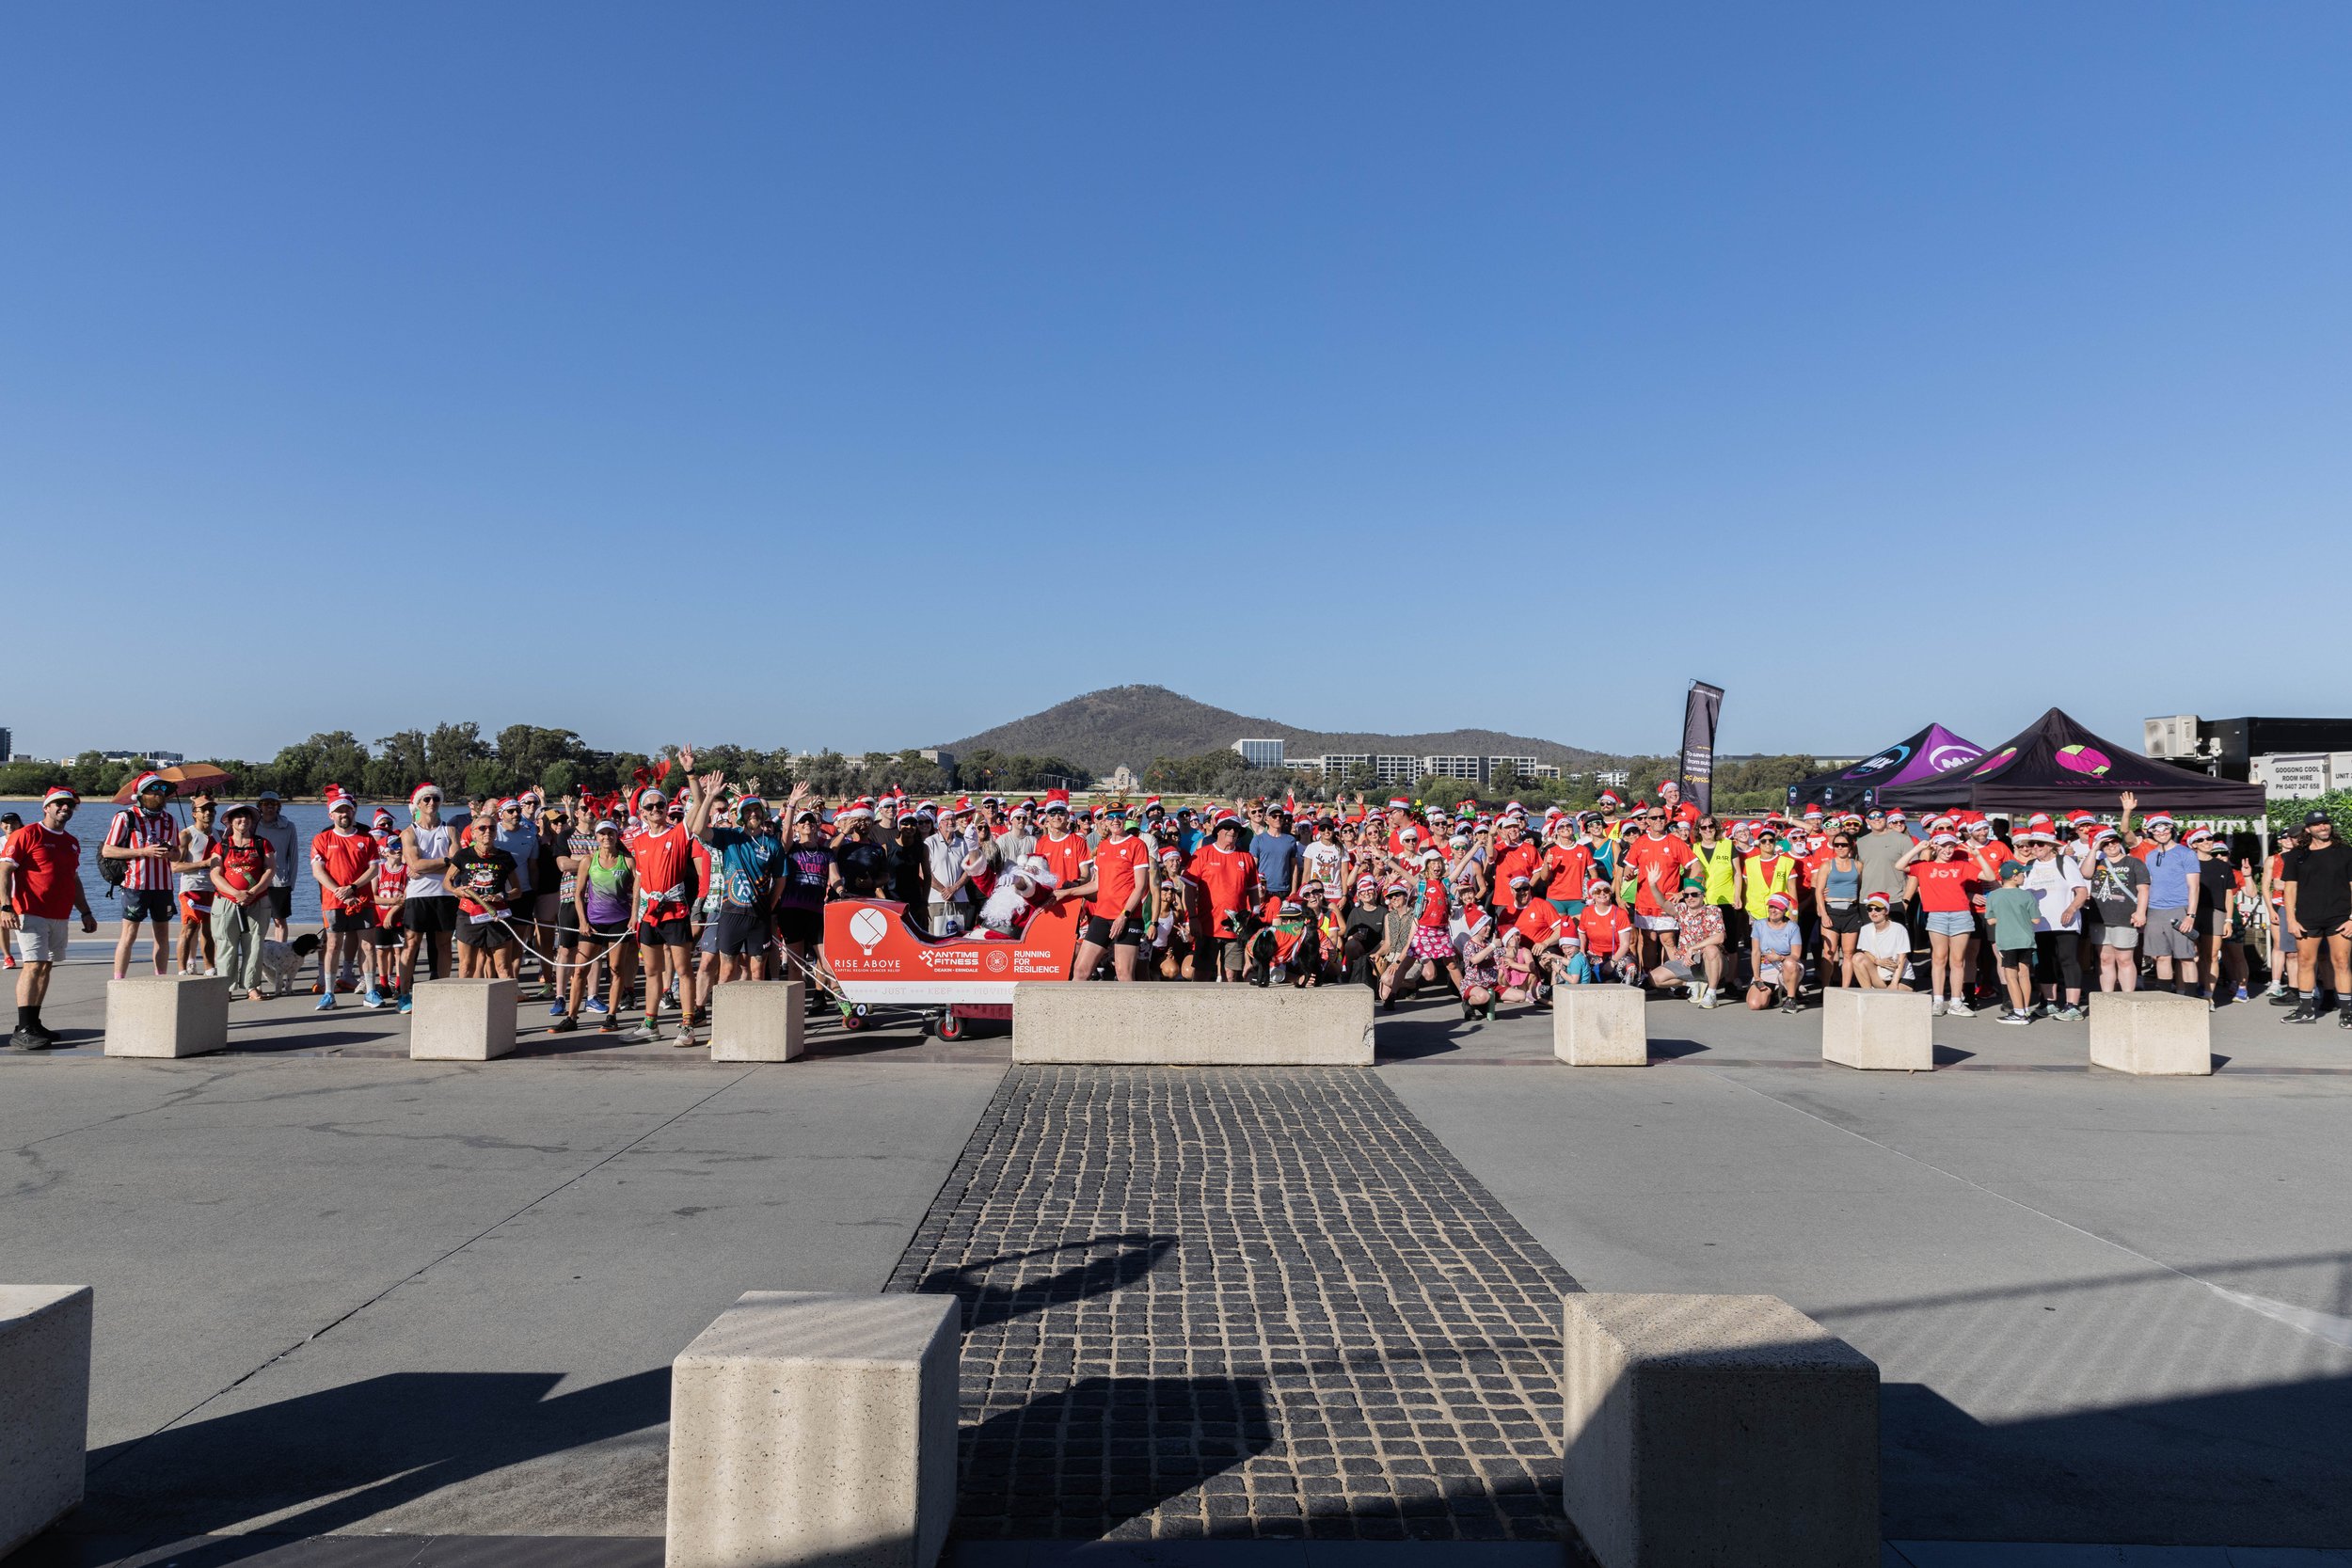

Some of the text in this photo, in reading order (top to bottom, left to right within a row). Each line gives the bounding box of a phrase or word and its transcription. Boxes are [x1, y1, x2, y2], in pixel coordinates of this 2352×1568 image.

[1930, 867, 1960, 879] JOY
[1014, 950, 1051, 958] RUNNING
[834, 959, 901, 968] RISE ABOVE
[882, 987, 906, 995] JUST
[928, 987, 952, 995] KEEP
